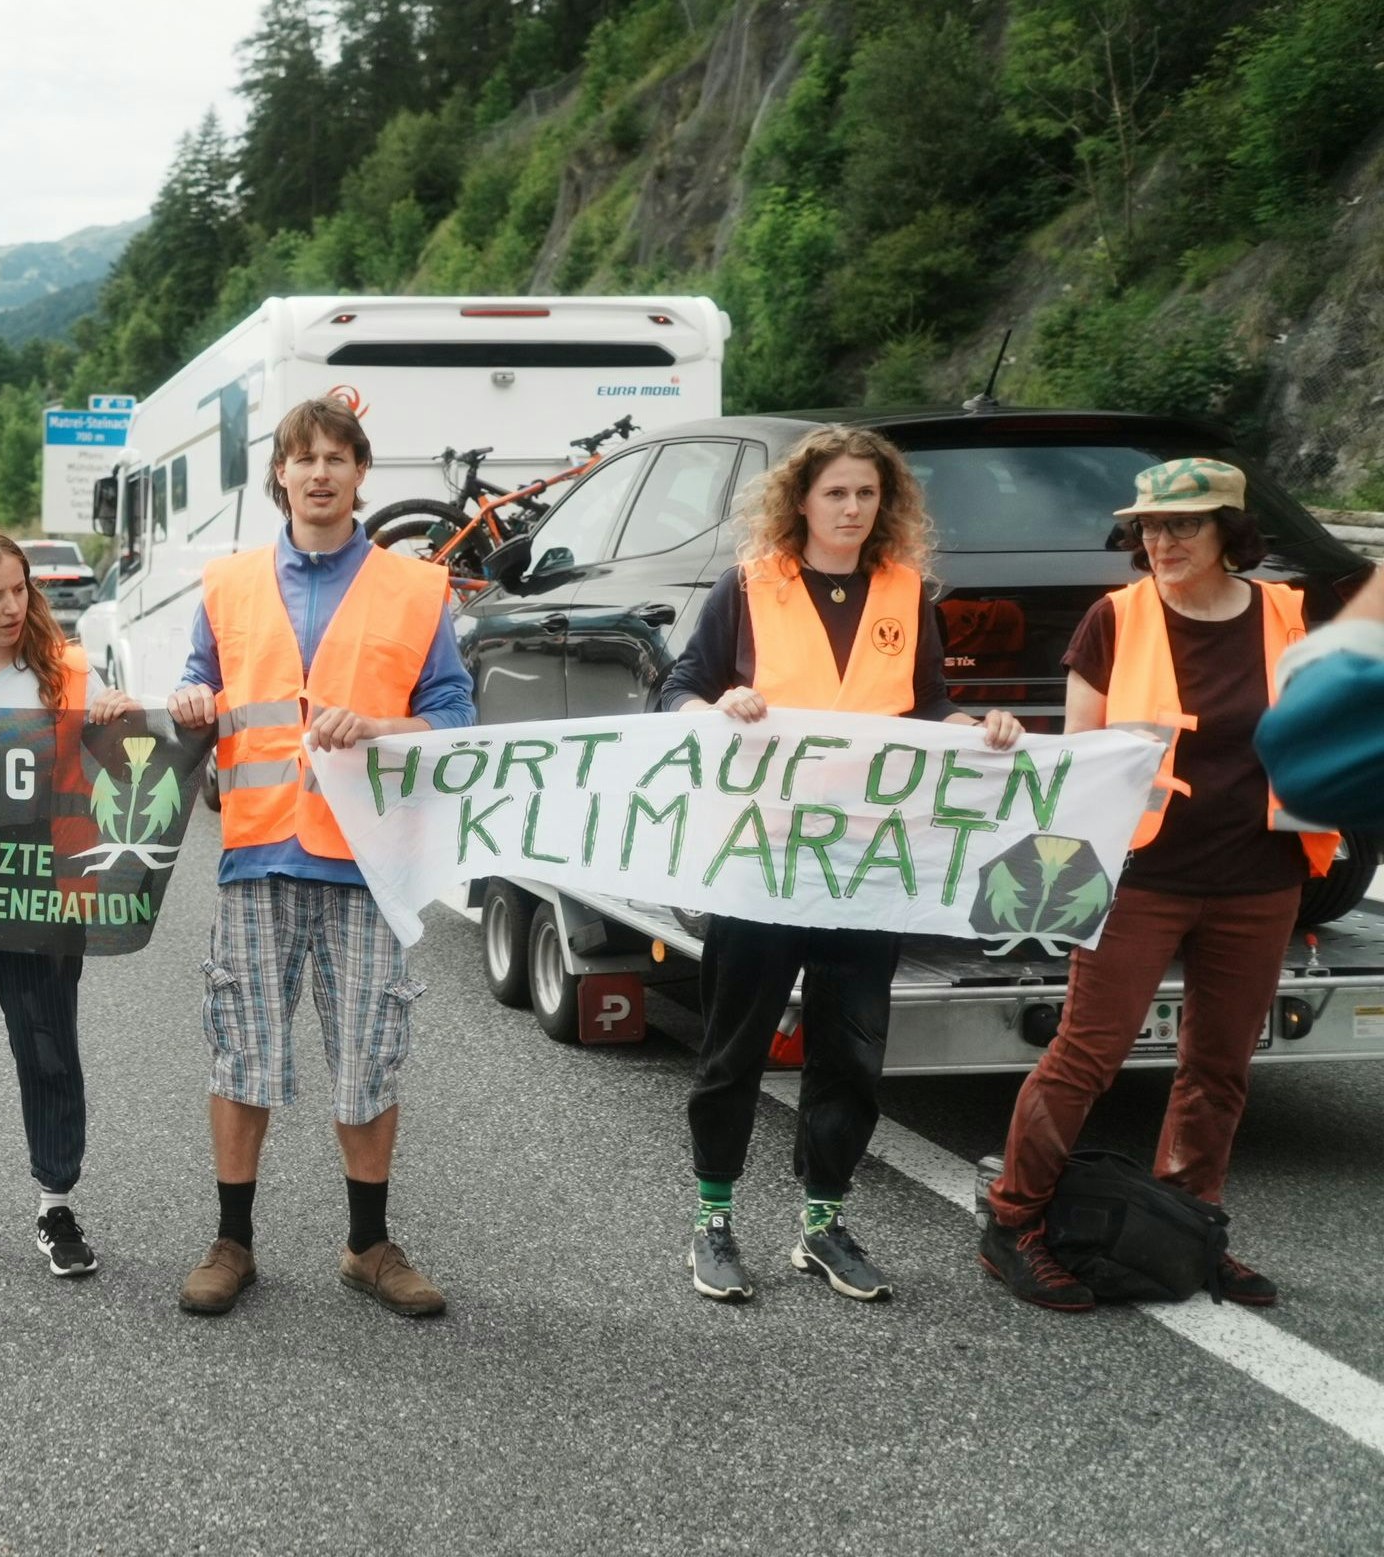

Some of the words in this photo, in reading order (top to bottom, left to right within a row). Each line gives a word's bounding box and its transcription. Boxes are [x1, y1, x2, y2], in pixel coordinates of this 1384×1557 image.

[597, 386, 637, 396] EURA
[640, 386, 680, 396] MOBIL
[95, 434, 105, 442] m
[367, 731, 623, 817] HÖRT
[636, 729, 852, 800] AUF
[864, 743, 1074, 831] DEN
